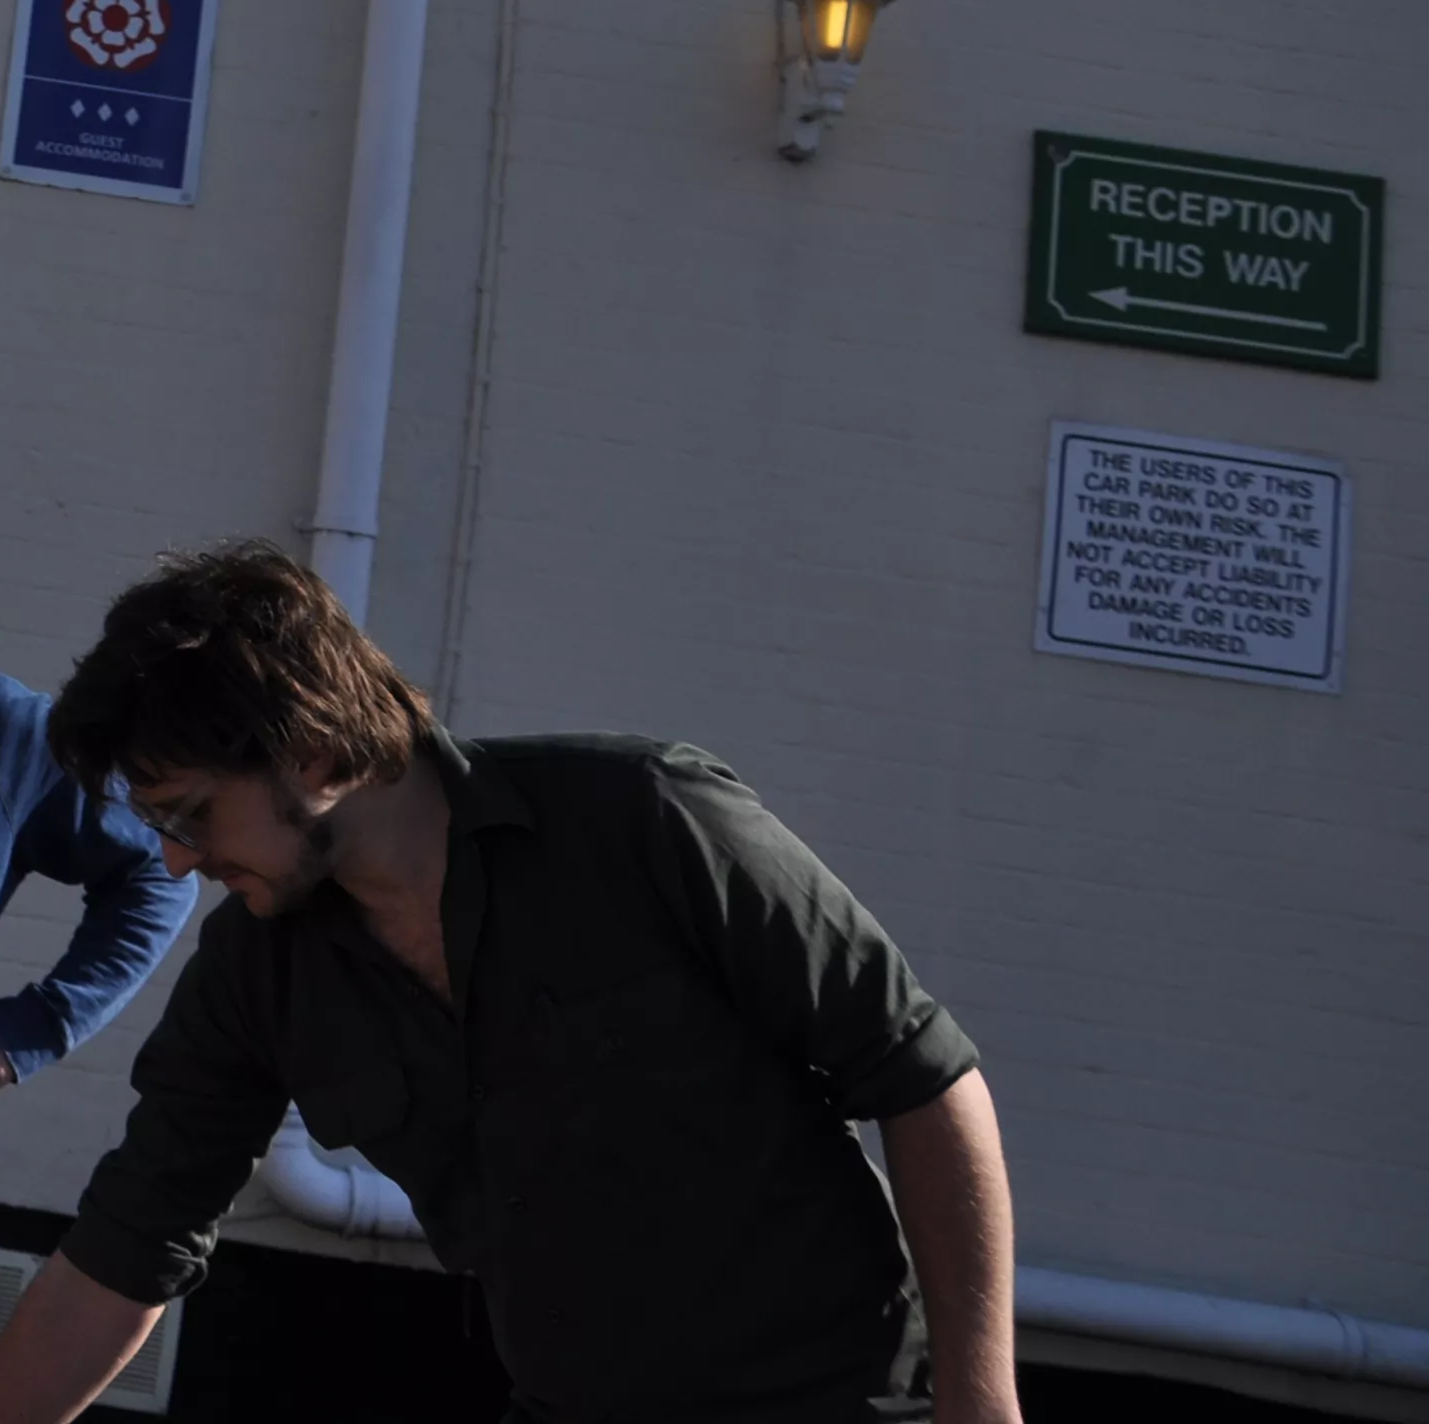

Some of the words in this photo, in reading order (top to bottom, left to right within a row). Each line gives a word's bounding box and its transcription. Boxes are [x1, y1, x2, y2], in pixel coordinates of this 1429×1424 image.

[35, 140, 165, 169] ACCOMMODATION
[78, 132, 125, 149] GUEST
[1090, 178, 1333, 244] RECEPTION
[1109, 233, 1204, 279] THIS
[1223, 250, 1310, 292] WAY
[1083, 472, 1130, 495] CAR
[1138, 480, 1197, 506] PARK
[1205, 489, 1239, 511] DO
[1246, 496, 1280, 517] SO
[1286, 503, 1315, 522] AT
[1089, 449, 1132, 473] THE
[1141, 456, 1216, 485] USERS
[1224, 469, 1255, 490] OF
[1263, 475, 1314, 499] THIS
[1075, 494, 1141, 521] THEIR
[1148, 506, 1204, 529] OWN
[1277, 524, 1322, 548] THE
[1086, 519, 1245, 560] MANAGEMENT
[1252, 546, 1306, 570] WILL
[1066, 541, 1114, 563] NOT
[1121, 549, 1211, 578] ACCEPT
[1218, 563, 1323, 595] LIABILITY
[1074, 565, 1121, 588] FOR
[1129, 574, 1176, 596] ANY
[1181, 582, 1312, 618] ACCIDENTS
[1088, 590, 1184, 623] DAMAGE
[1191, 606, 1225, 627] OR
[1232, 613, 1296, 639] LOSS
[1128, 621, 1252, 656] INCURRED.
